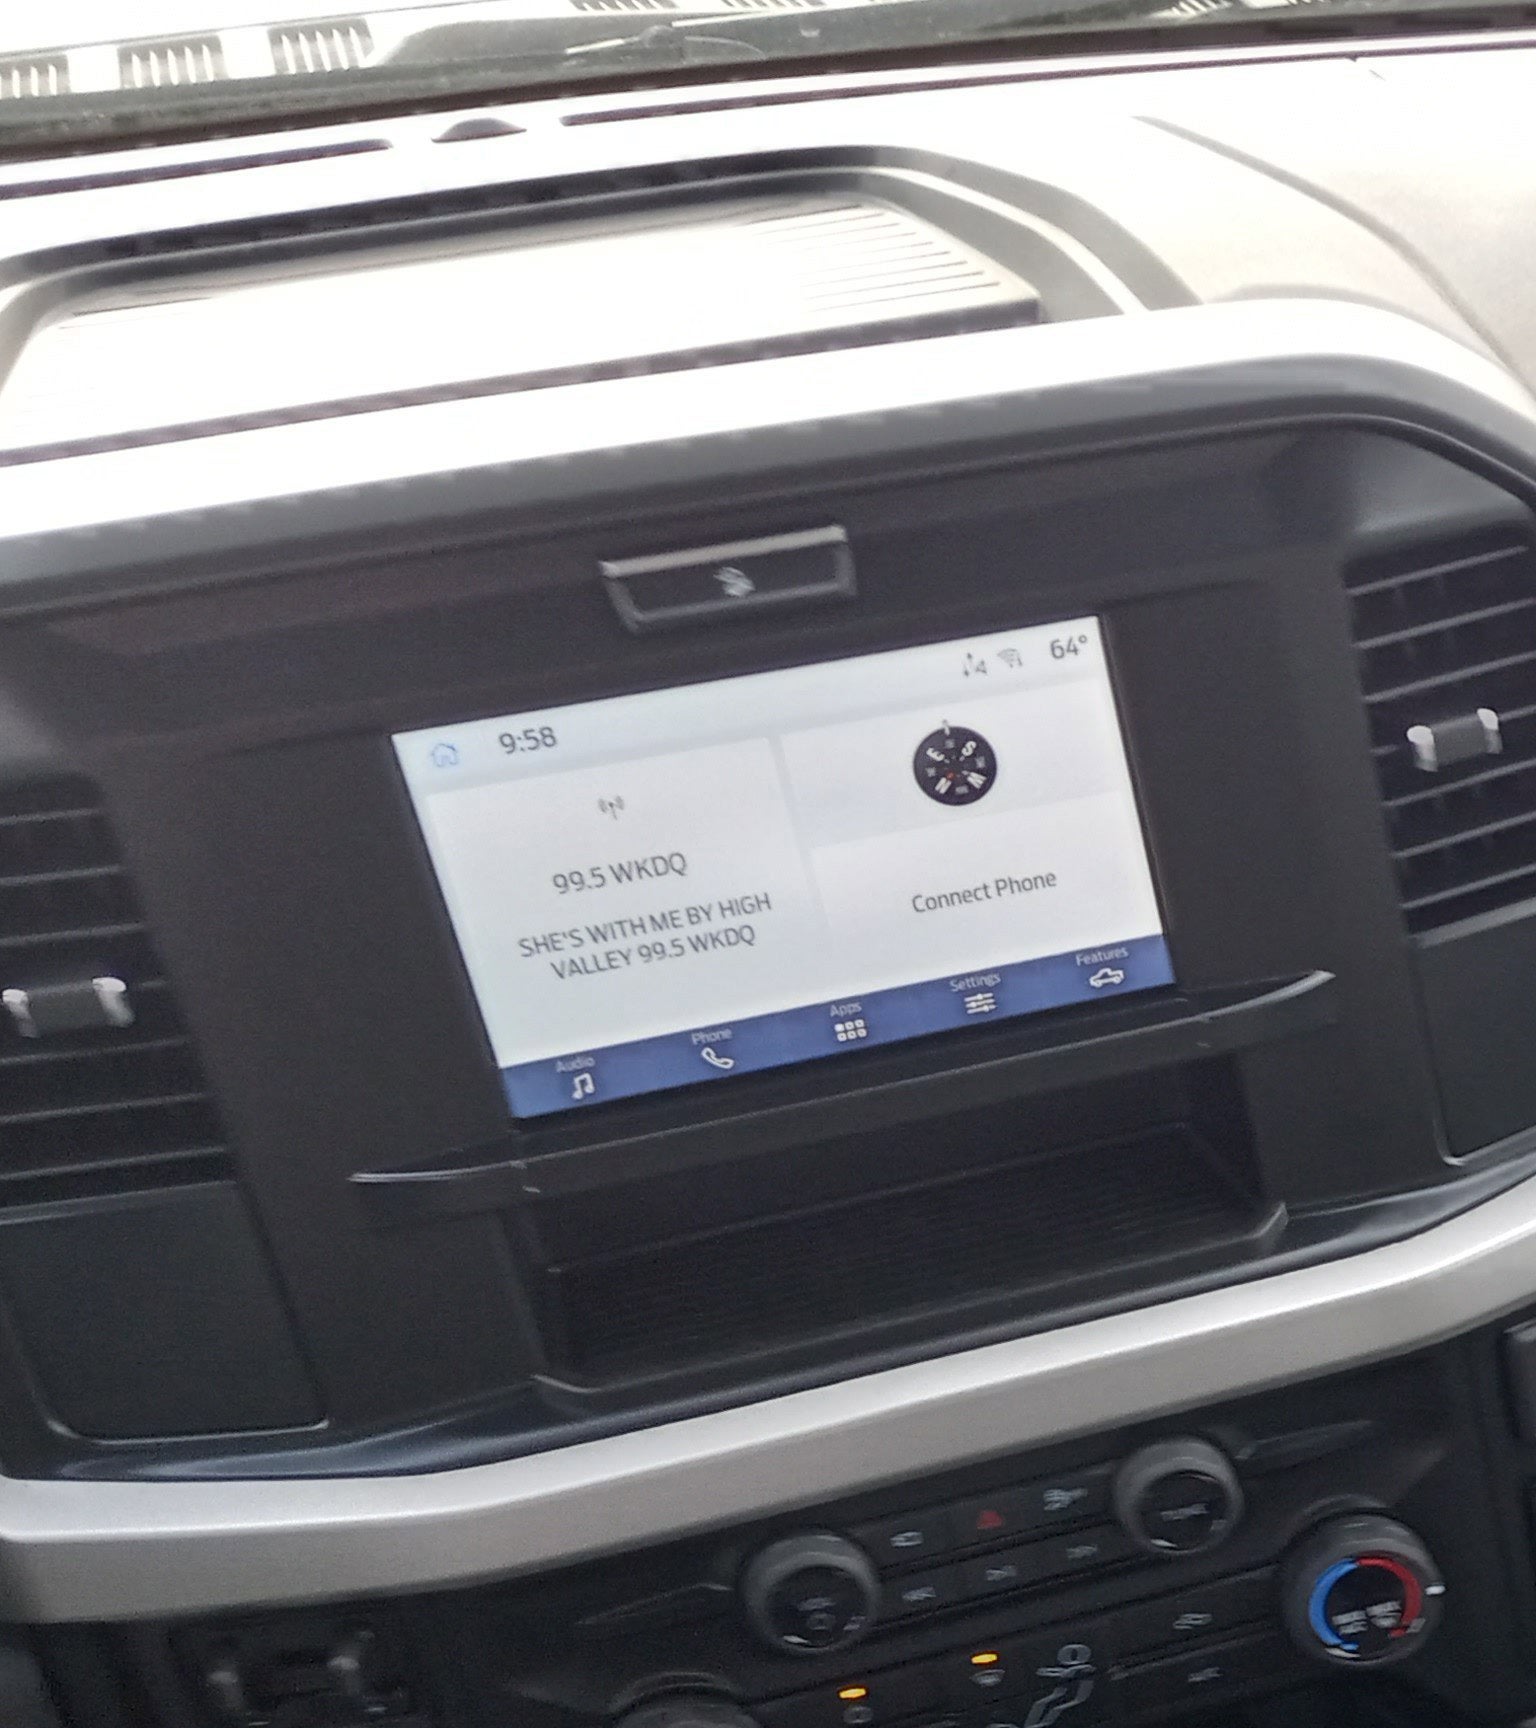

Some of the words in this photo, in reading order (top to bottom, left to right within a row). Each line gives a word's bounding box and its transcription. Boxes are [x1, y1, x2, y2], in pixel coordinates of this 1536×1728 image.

[1050, 634, 1088, 660] 64°
[498, 726, 558, 754] 9:58
[552, 866, 606, 894] 99.5
[608, 851, 688, 884] WKDQ
[911, 882, 992, 912] Connect
[994, 871, 1057, 898] Phone
[517, 928, 584, 958] SHE'S
[584, 916, 648, 945] WITH
[648, 908, 688, 933] ME
[686, 903, 714, 927] BY
[718, 891, 773, 918] HIGH
[550, 947, 634, 980] VALLEY
[636, 938, 686, 964] 99.5
[687, 924, 757, 952] WKDQ
[1075, 947, 1130, 967] Features
[949, 972, 1002, 993] Settings
[829, 1001, 863, 1019] Apps
[691, 1026, 734, 1046] Phone
[555, 1055, 597, 1074] Audio
